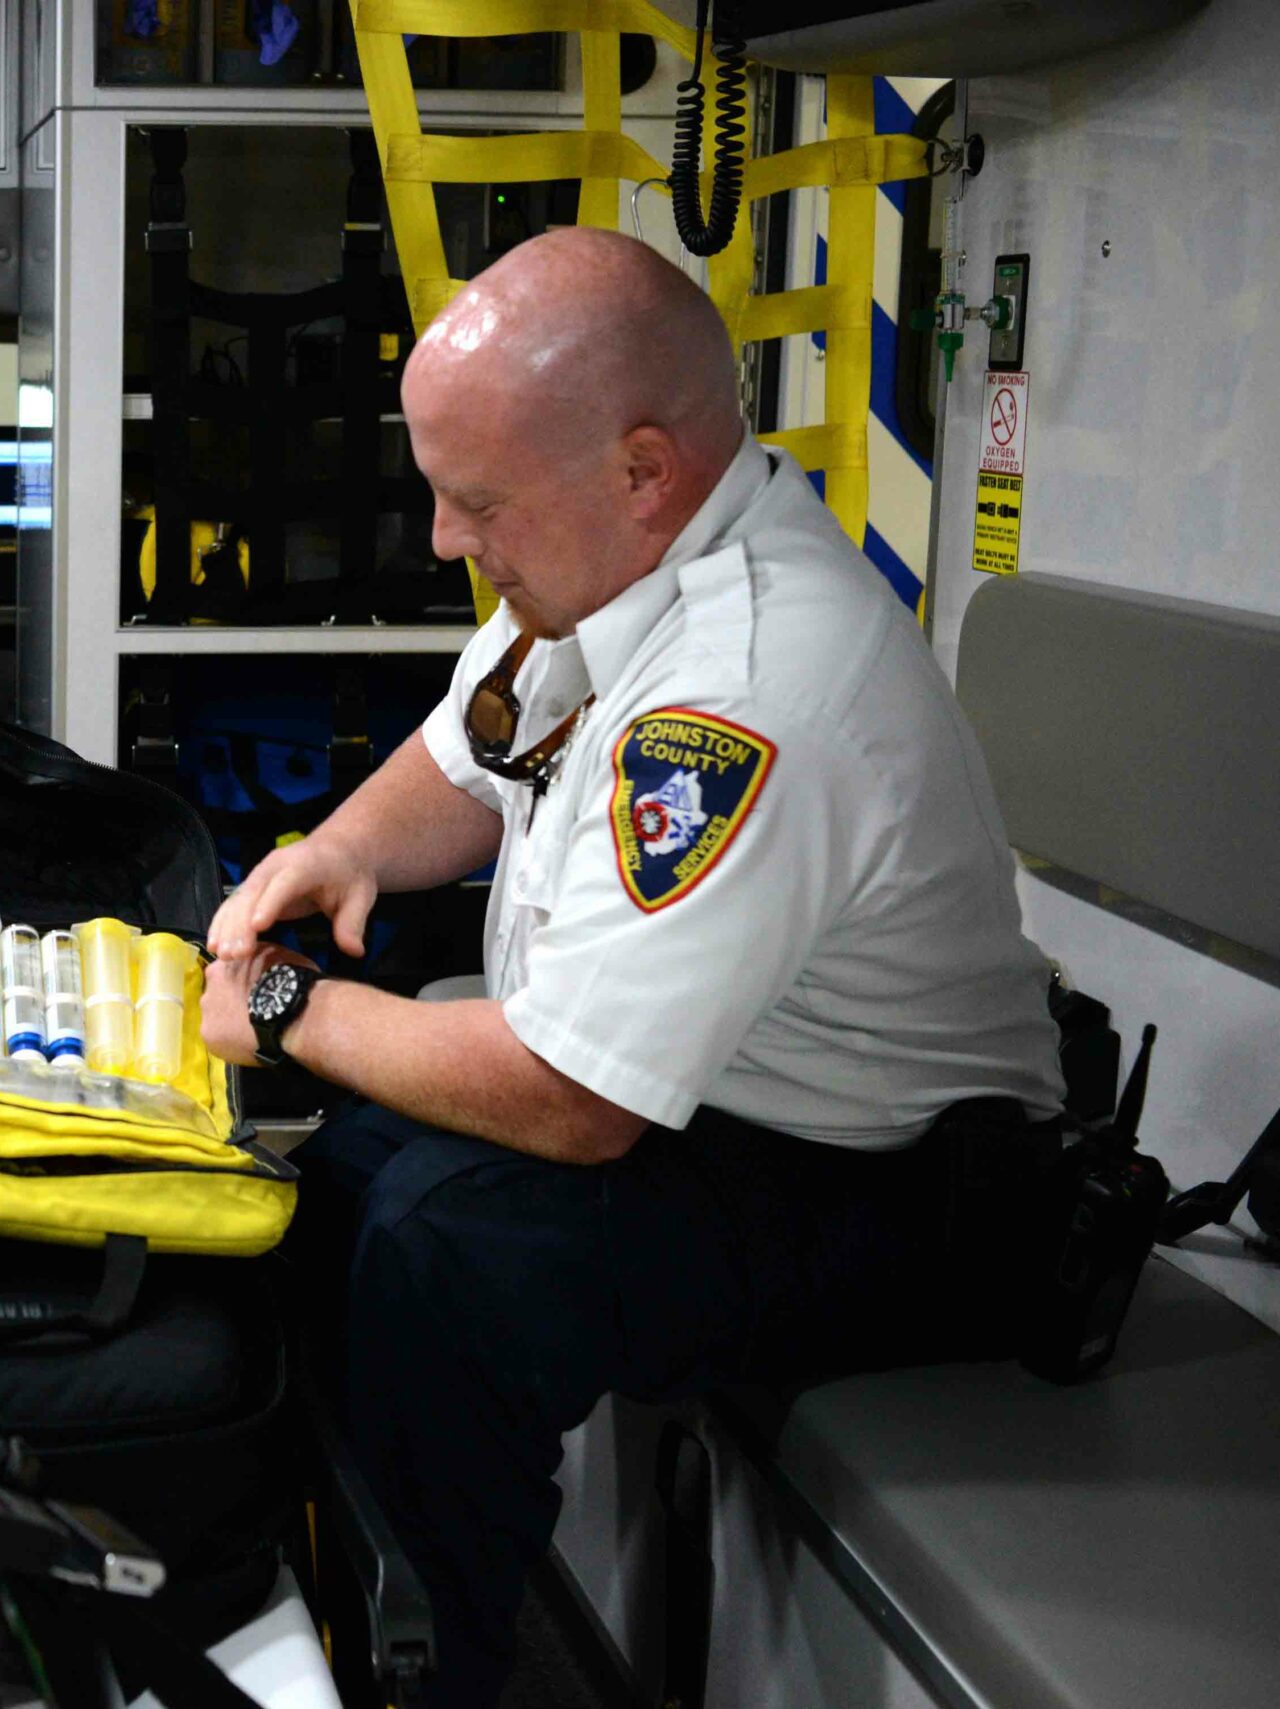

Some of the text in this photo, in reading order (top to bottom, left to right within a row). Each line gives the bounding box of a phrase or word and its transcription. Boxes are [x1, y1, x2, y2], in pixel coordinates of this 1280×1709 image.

[987, 374, 1025, 386] NO SMOKING
[982, 458, 1020, 472] EQUIPPED
[985, 446, 1016, 460] OXYGEN
[635, 721, 751, 765] JOHNSTON
[640, 740, 731, 776] COUNTY
[619, 779, 642, 872] EMERGENCY
[672, 814, 730, 881] SERVICES
